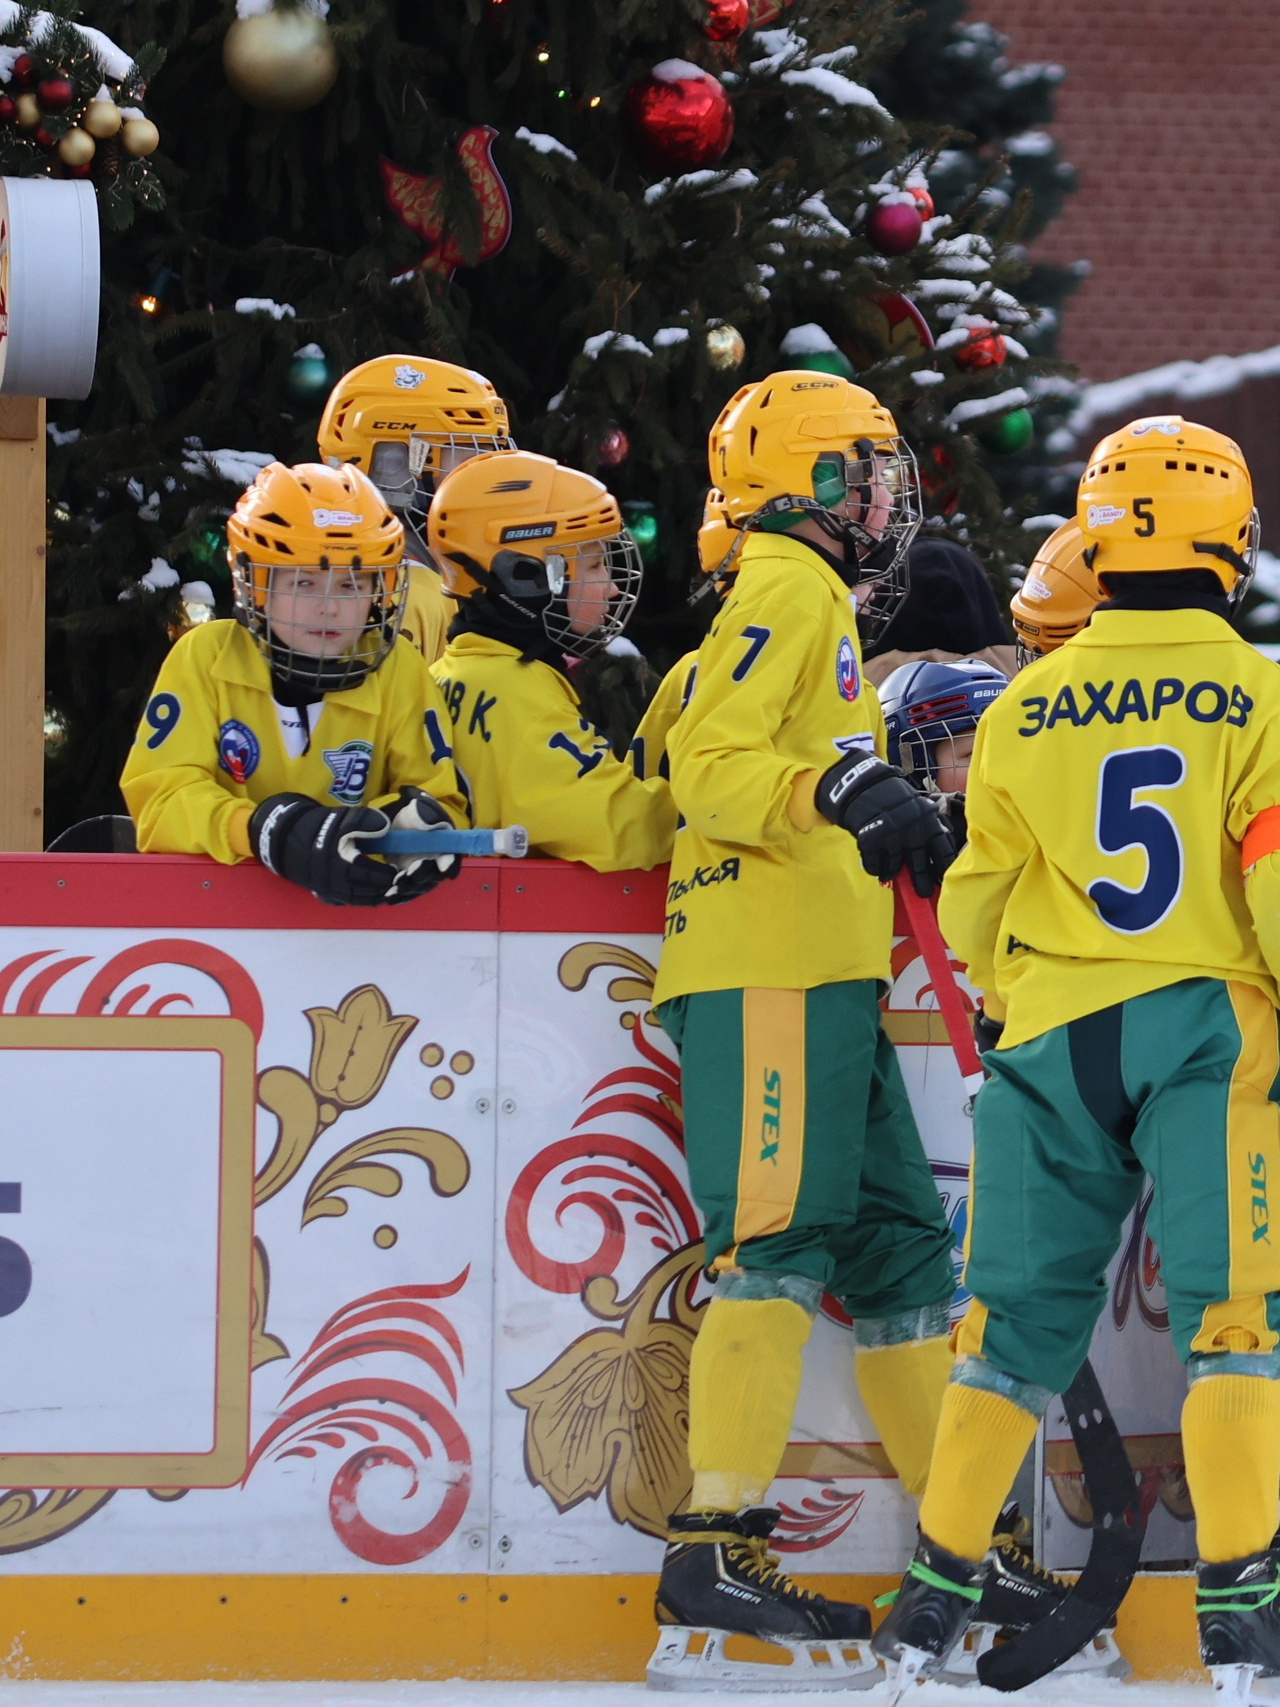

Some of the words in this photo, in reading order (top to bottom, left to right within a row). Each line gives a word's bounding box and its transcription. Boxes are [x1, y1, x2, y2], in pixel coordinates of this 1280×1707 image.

[792, 380, 839, 391] CCM
[372, 421, 418, 431] CCM
[1133, 497, 1156, 538] 5
[504, 528, 554, 541] BAUER
[499, 593, 537, 620] BAUER
[730, 624, 771, 682] 7
[973, 688, 1003, 698] BAU
[1018, 677, 1254, 737] ЗАХАРОВ
[315, 812, 337, 849] CARBON
[1086, 744, 1187, 935] 5
[760, 1066, 782, 1168] STEX
[1246, 1151, 1272, 1248] STEX
[715, 1581, 763, 1606] BAUER
[997, 1576, 1041, 1600] BAUER
